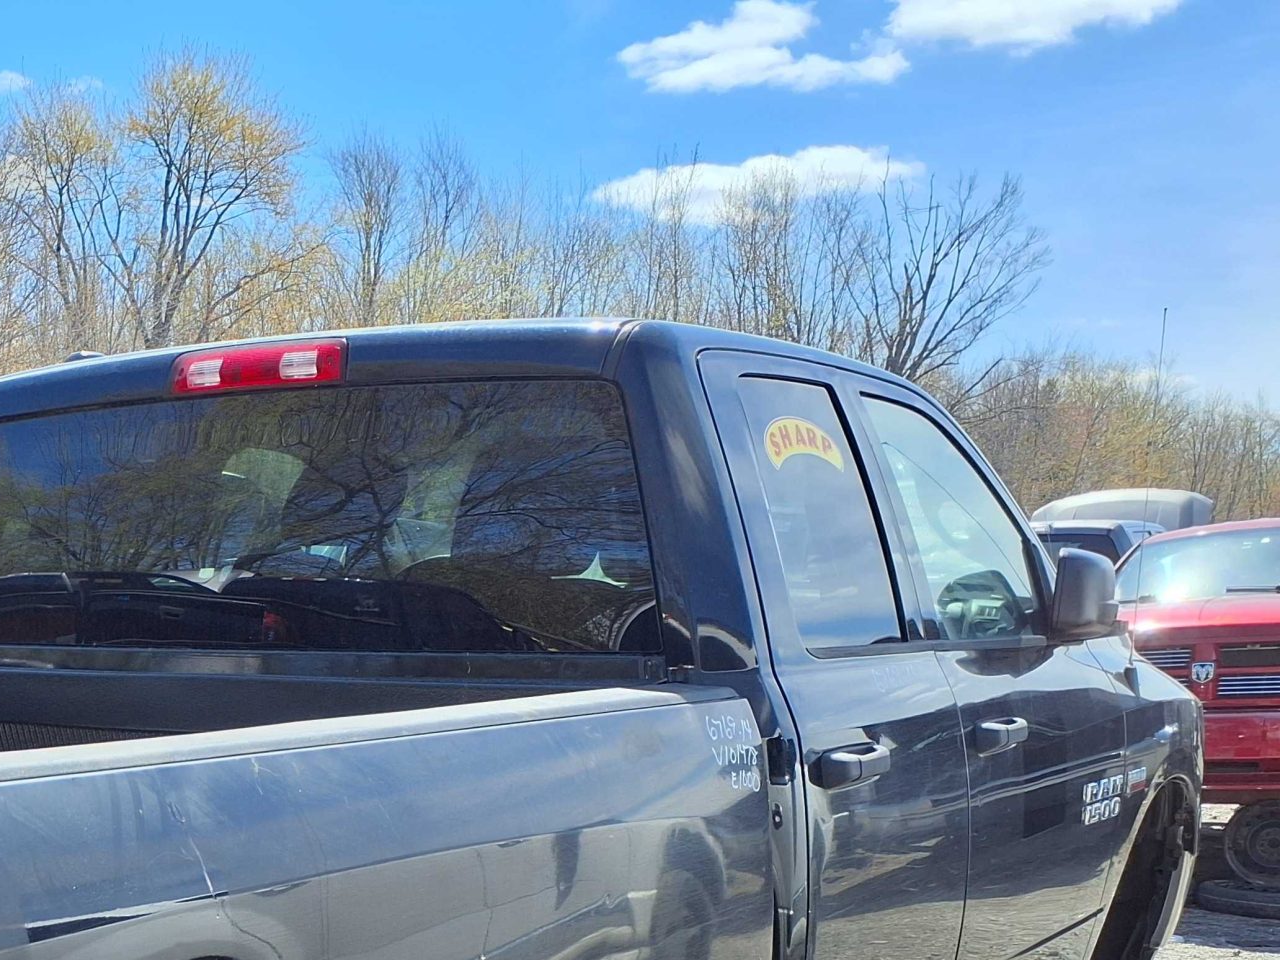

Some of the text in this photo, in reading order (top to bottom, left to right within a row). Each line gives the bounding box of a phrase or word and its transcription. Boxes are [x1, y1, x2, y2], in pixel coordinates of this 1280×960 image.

[769, 423, 832, 457] SHARP
[1083, 775, 1123, 803] RAM
[1082, 797, 1121, 825] 1500
